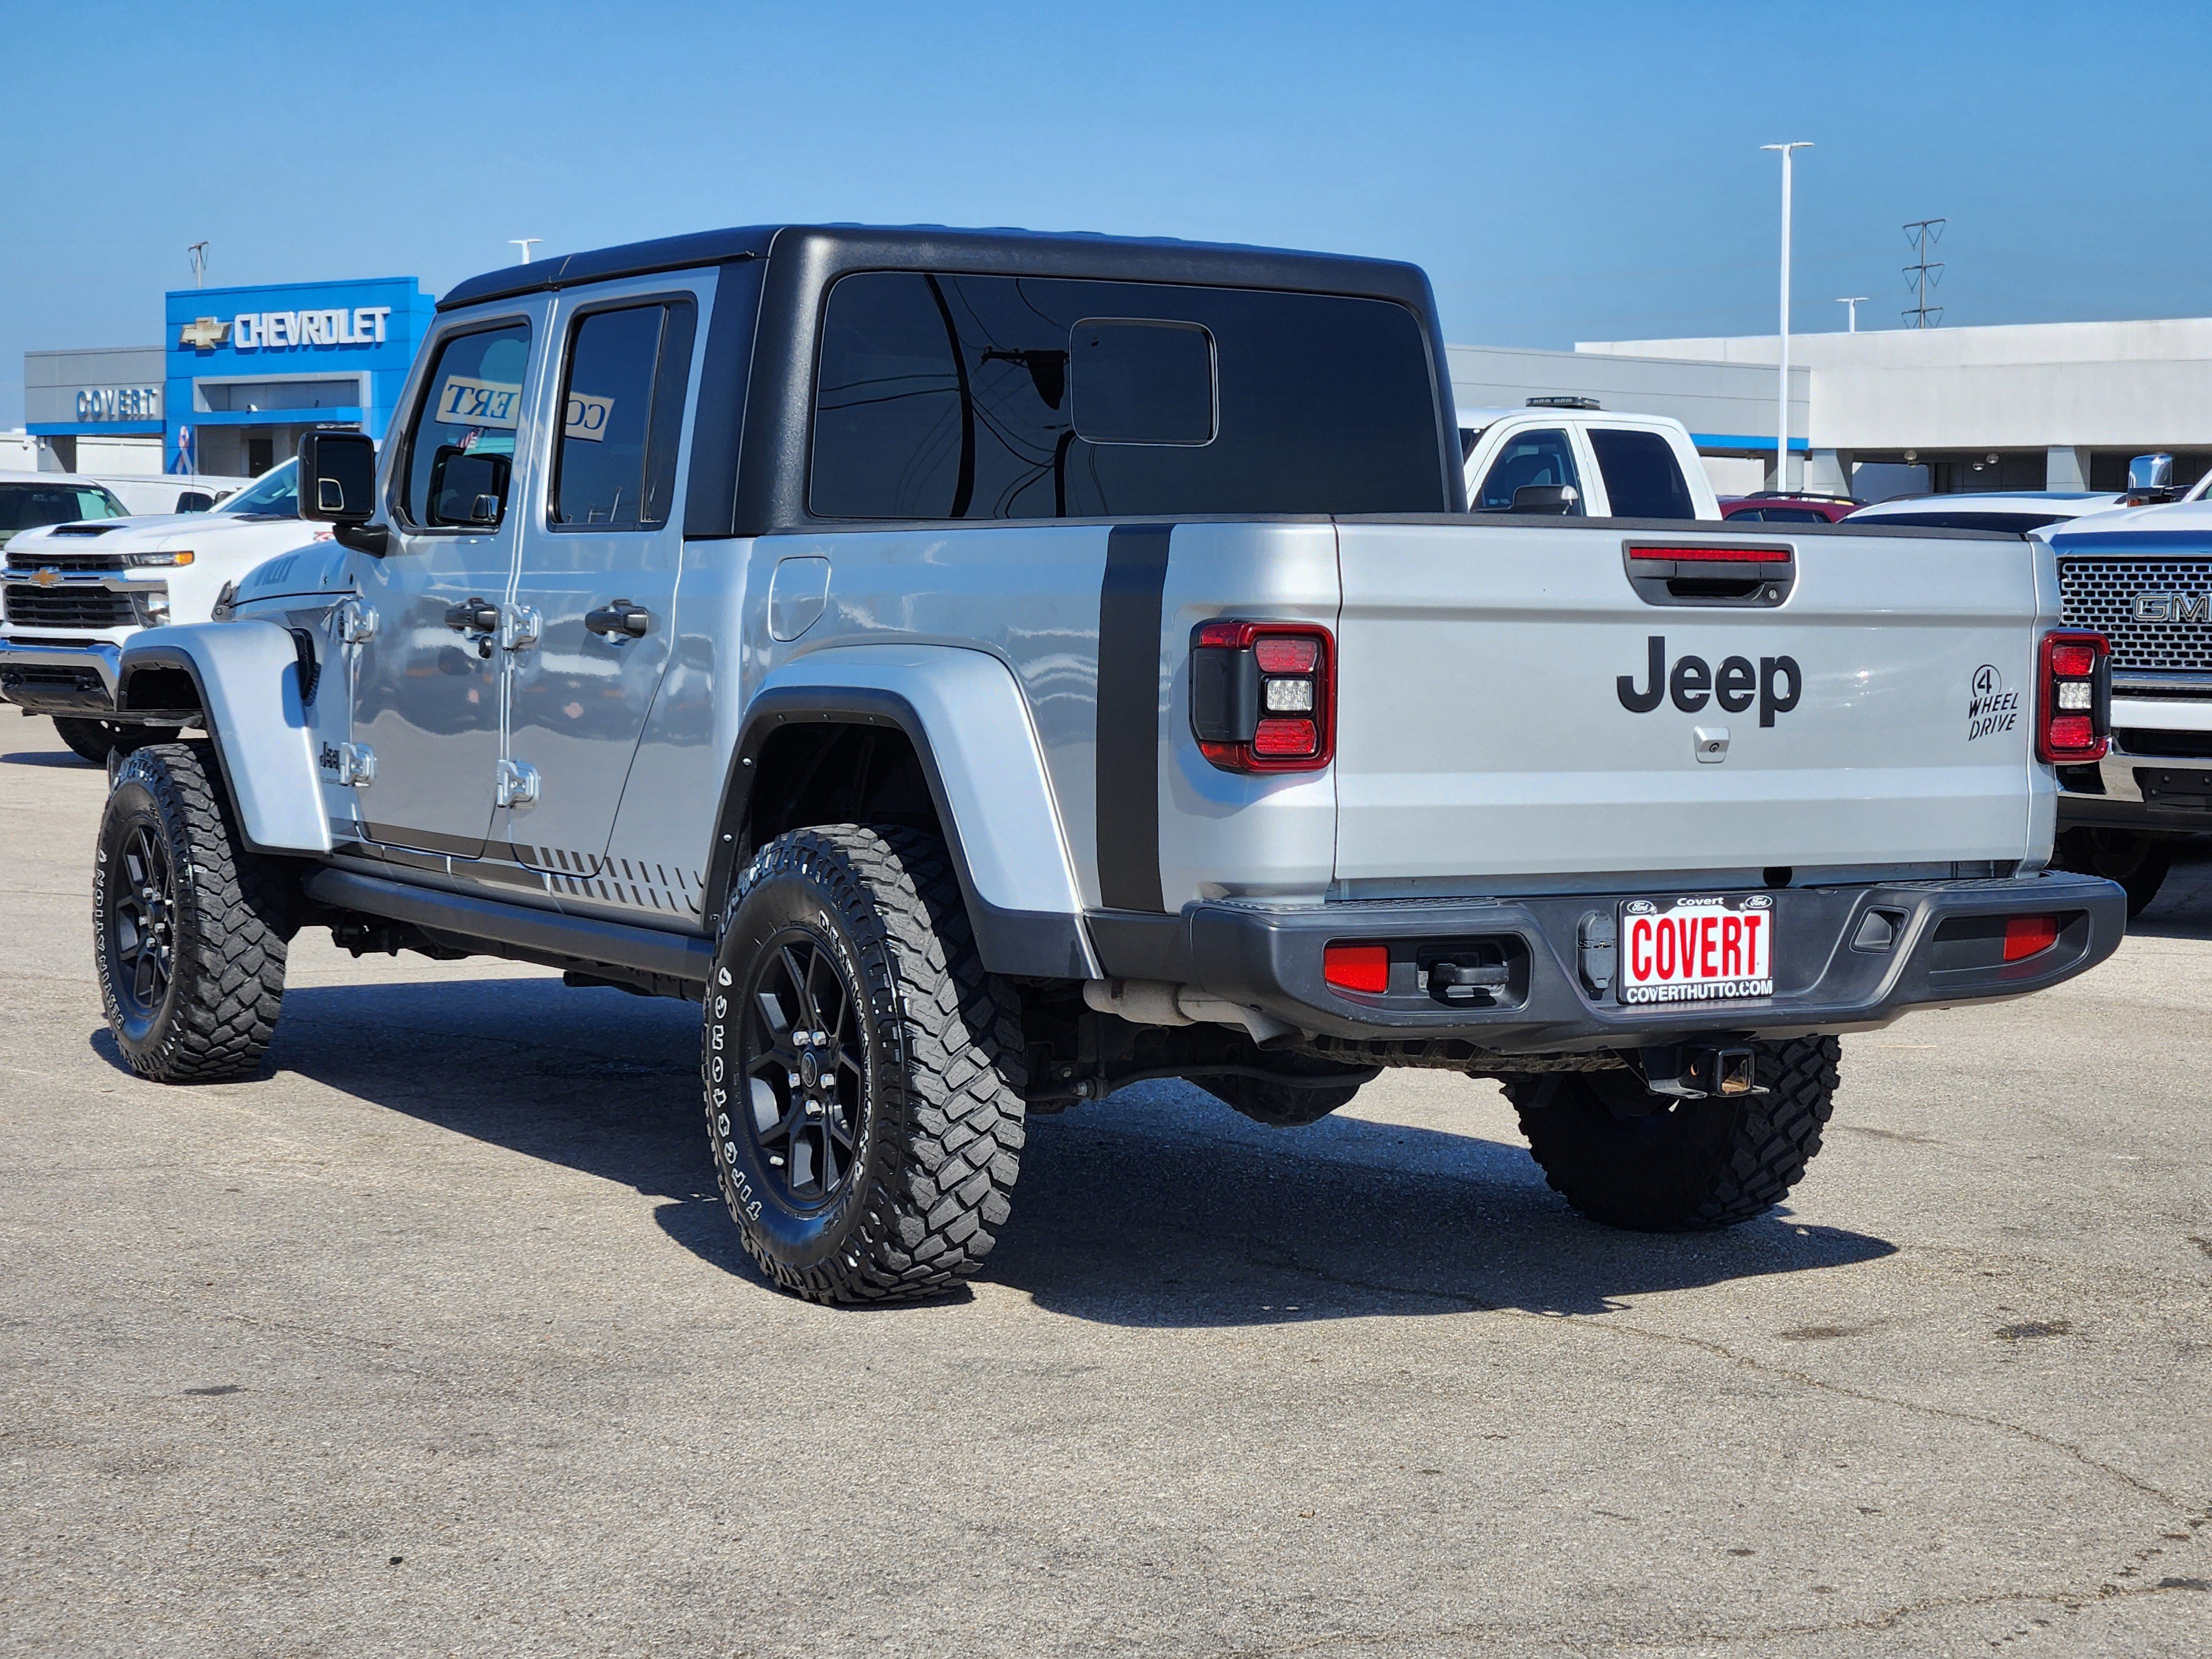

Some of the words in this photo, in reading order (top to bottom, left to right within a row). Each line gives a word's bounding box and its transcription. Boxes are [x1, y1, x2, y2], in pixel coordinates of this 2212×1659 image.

[234, 306, 391, 348] CHEVROLET
[76, 388, 158, 418] COVERT
[2133, 592, 2212, 623] GM
[1616, 636, 1802, 728] Jeep
[1977, 669, 1992, 694] 4
[1968, 692, 2019, 719] WHEEL
[1968, 713, 2017, 742] DRIVE
[1677, 896, 1724, 906] Covert
[1632, 915, 1761, 982] COVERT
[1626, 980, 1772, 1003] COVERTHUTTO.COM
